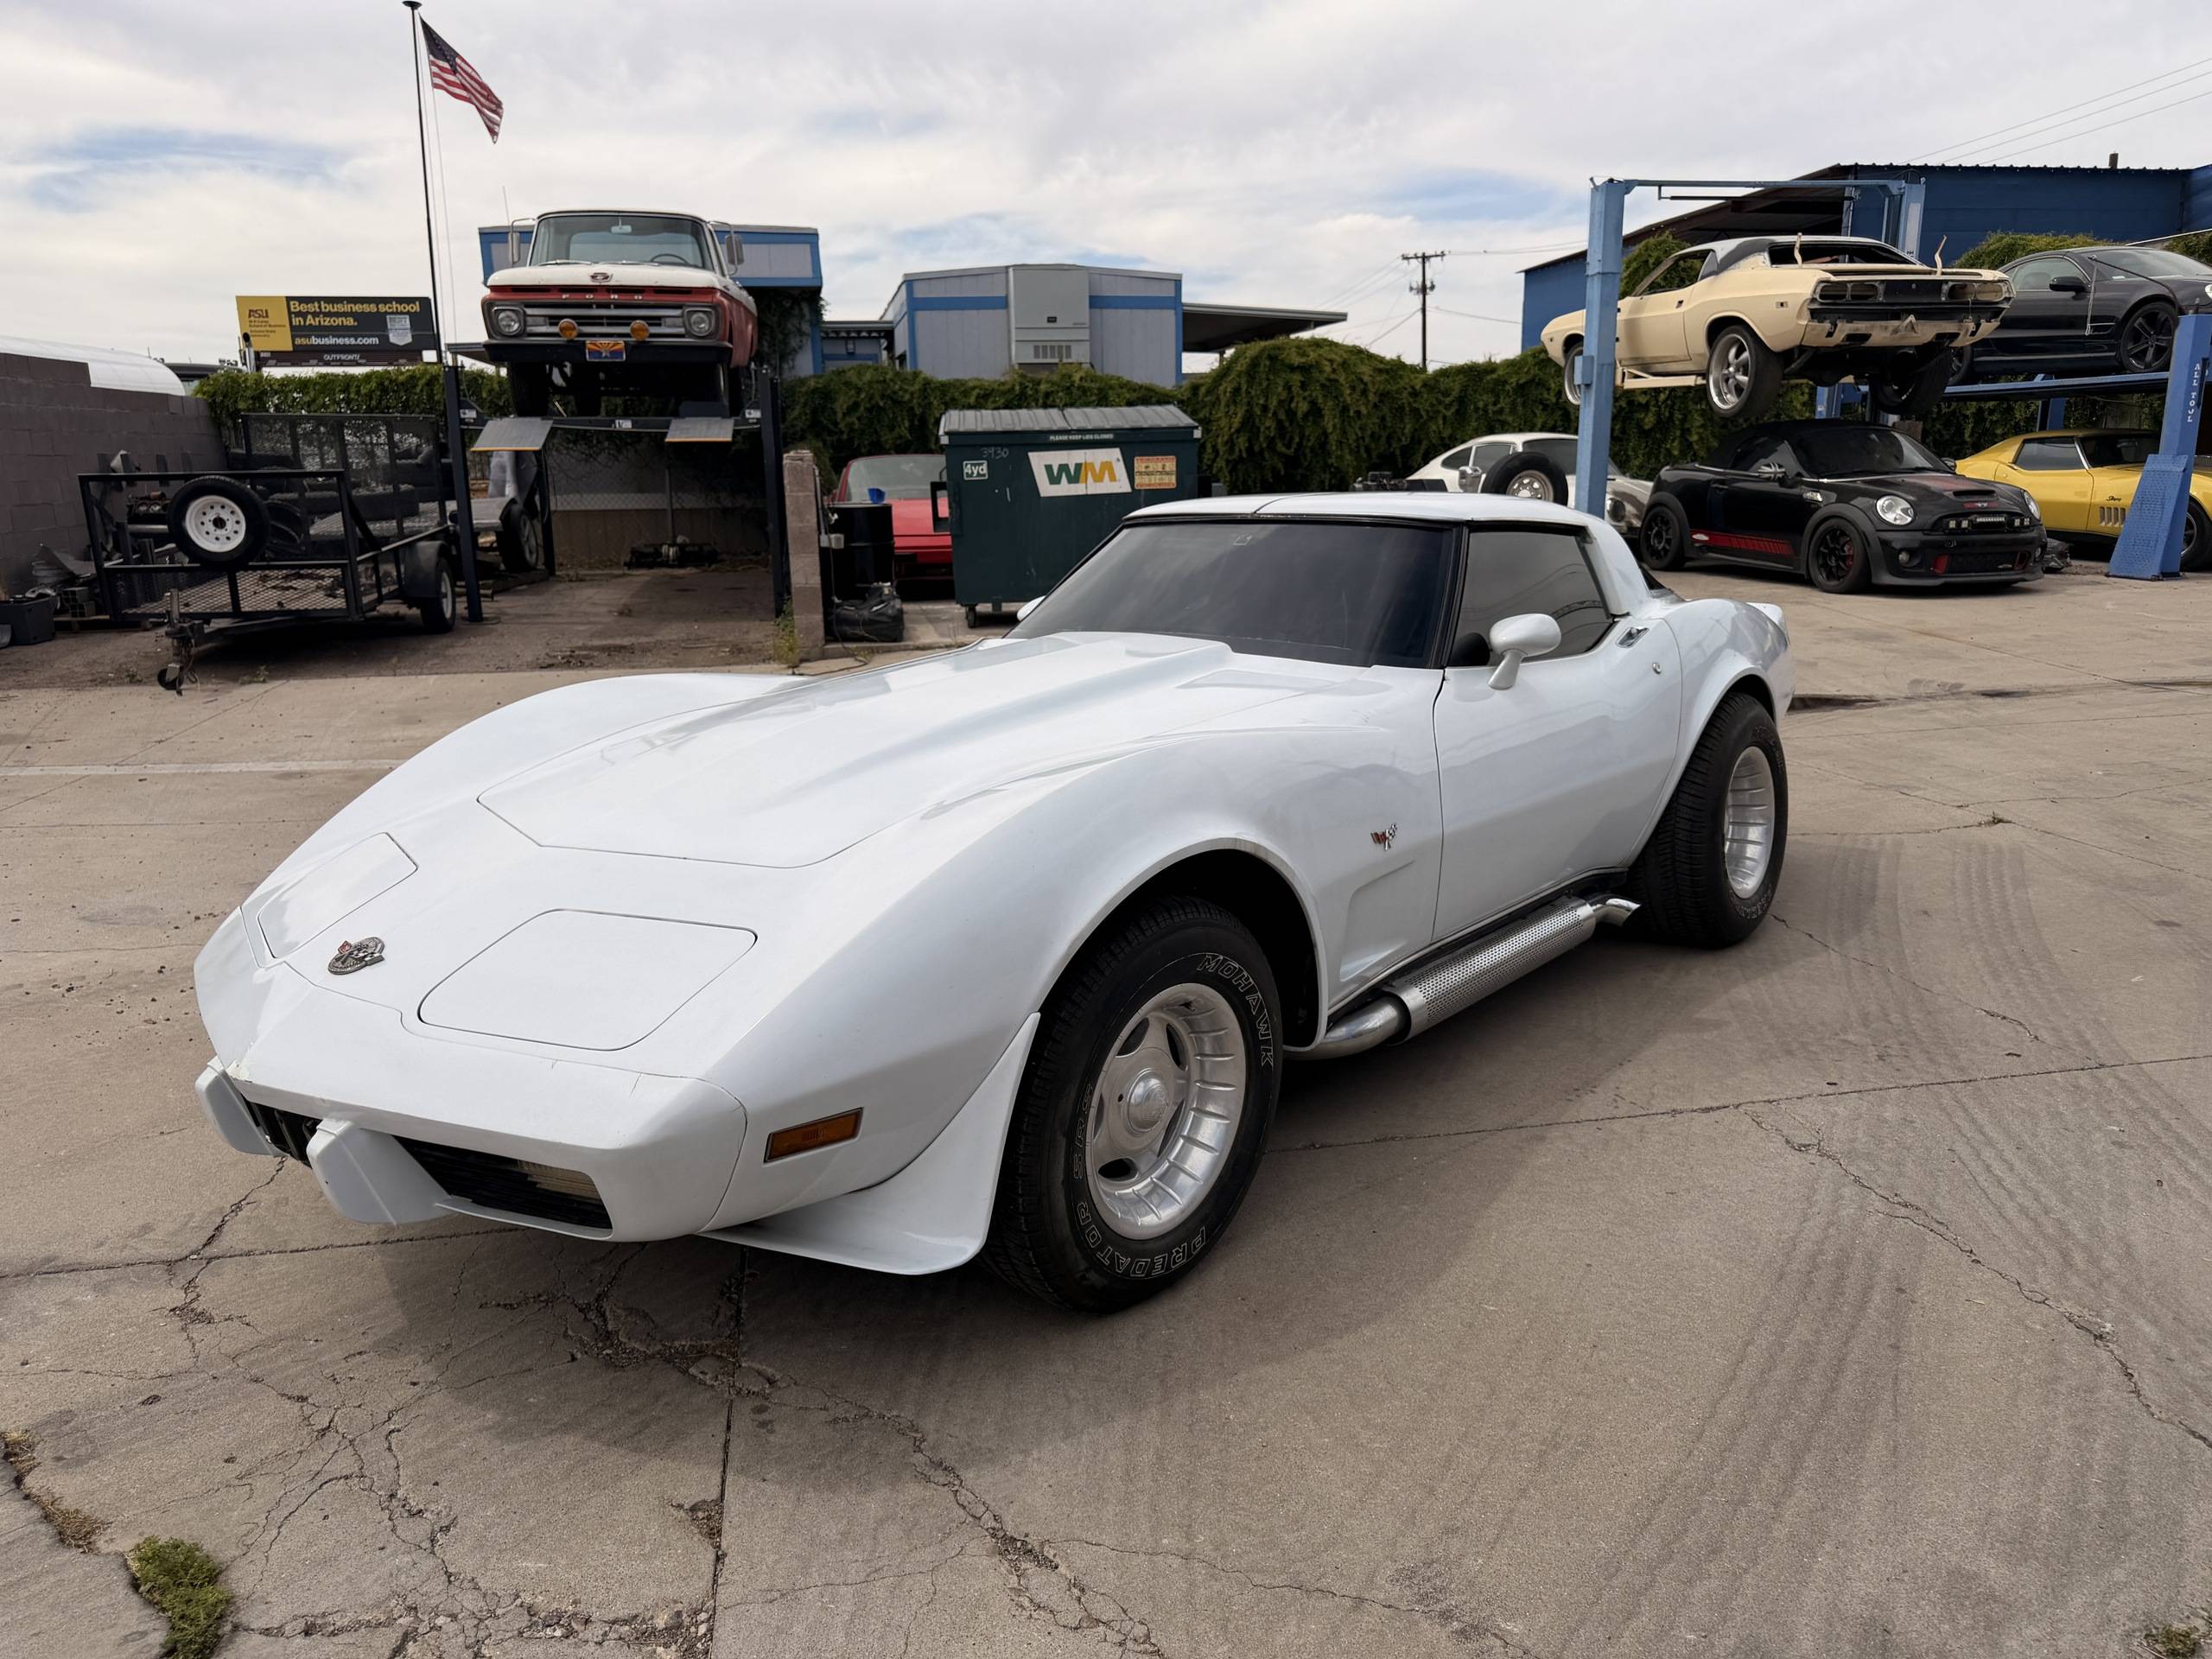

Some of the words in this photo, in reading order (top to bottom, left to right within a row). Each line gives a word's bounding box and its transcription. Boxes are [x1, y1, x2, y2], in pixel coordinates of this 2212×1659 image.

[248, 308, 270, 318] ASU
[290, 302, 322, 312] Best
[322, 302, 377, 312] business
[378, 302, 420, 312] school
[292, 315, 305, 326] in
[306, 315, 358, 326] Arizona.
[295, 335, 379, 346] asubusiness.com
[2192, 363, 2201, 386] ALL
[964, 463, 986, 477] 4yd
[1044, 461, 1117, 486] WM
[1197, 953, 1274, 1070] MOHAWK
[1076, 1199, 1208, 1278] PREDATOR
